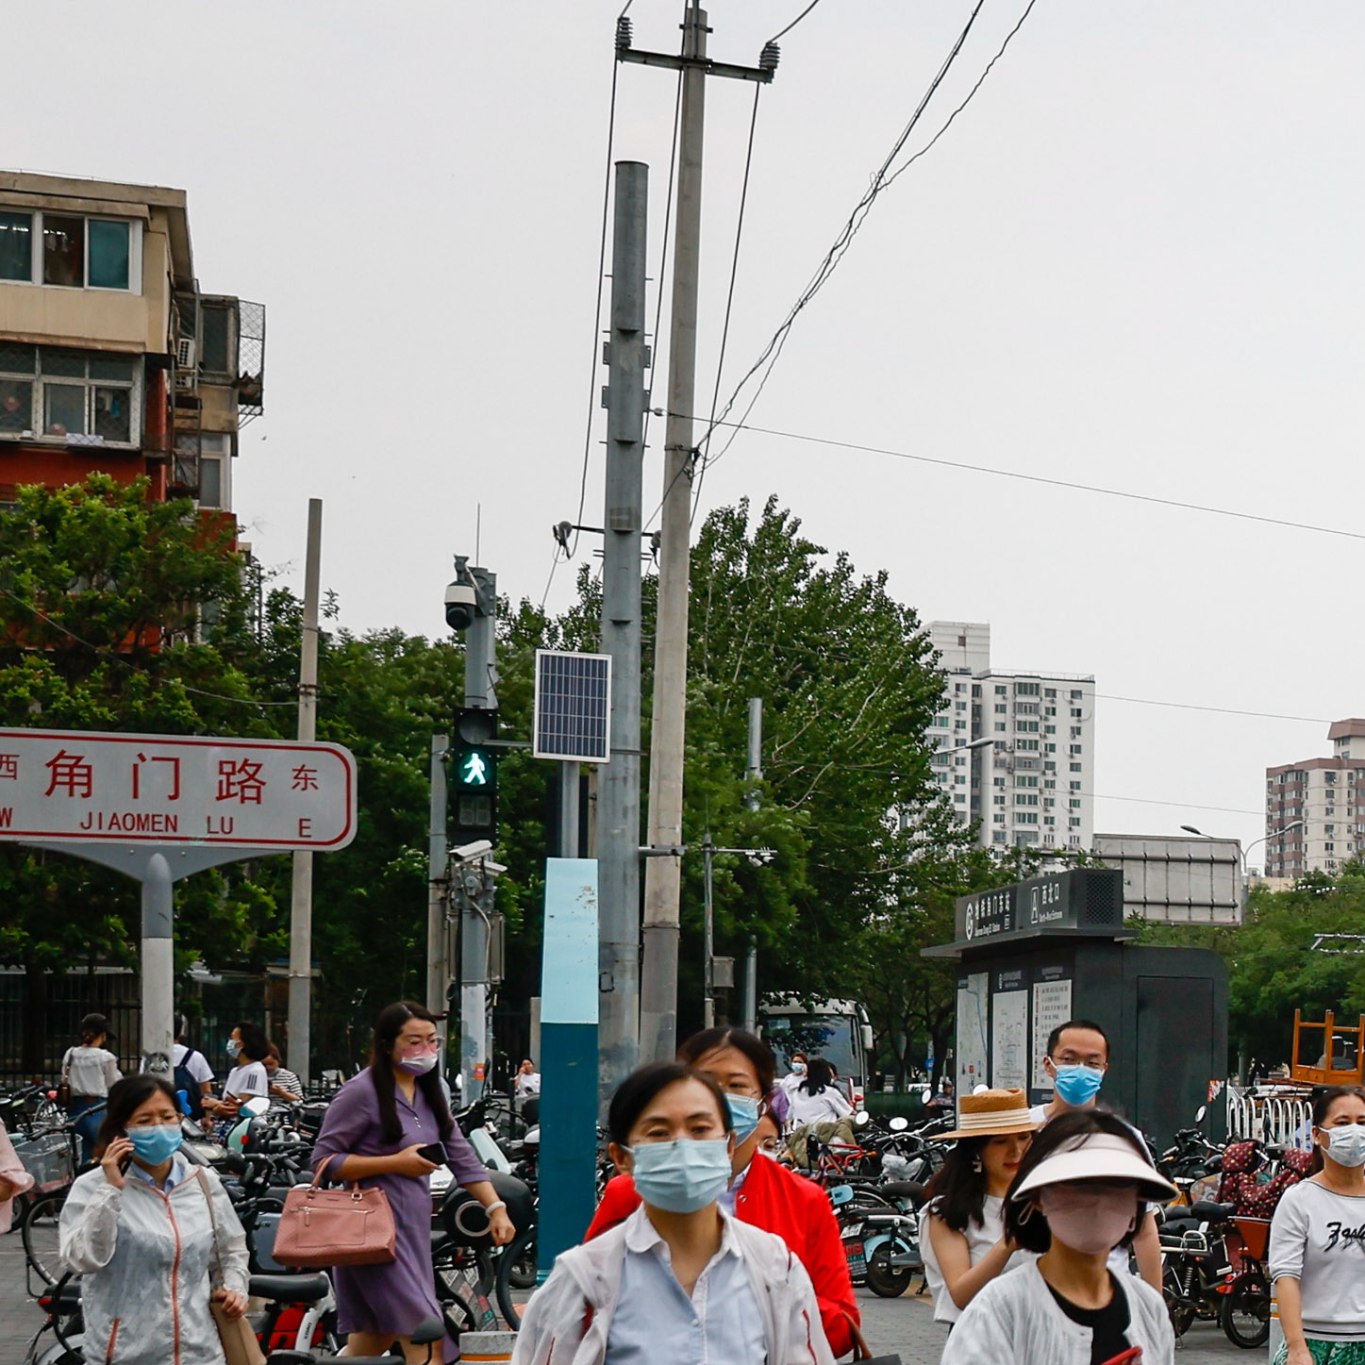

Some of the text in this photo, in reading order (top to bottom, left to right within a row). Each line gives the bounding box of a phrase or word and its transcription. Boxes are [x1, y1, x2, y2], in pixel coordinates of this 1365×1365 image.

[45, 749, 266, 805] 角门路
[291, 764, 319, 791] 东
[0, 808, 311, 837] W JIAOMEN LU E
